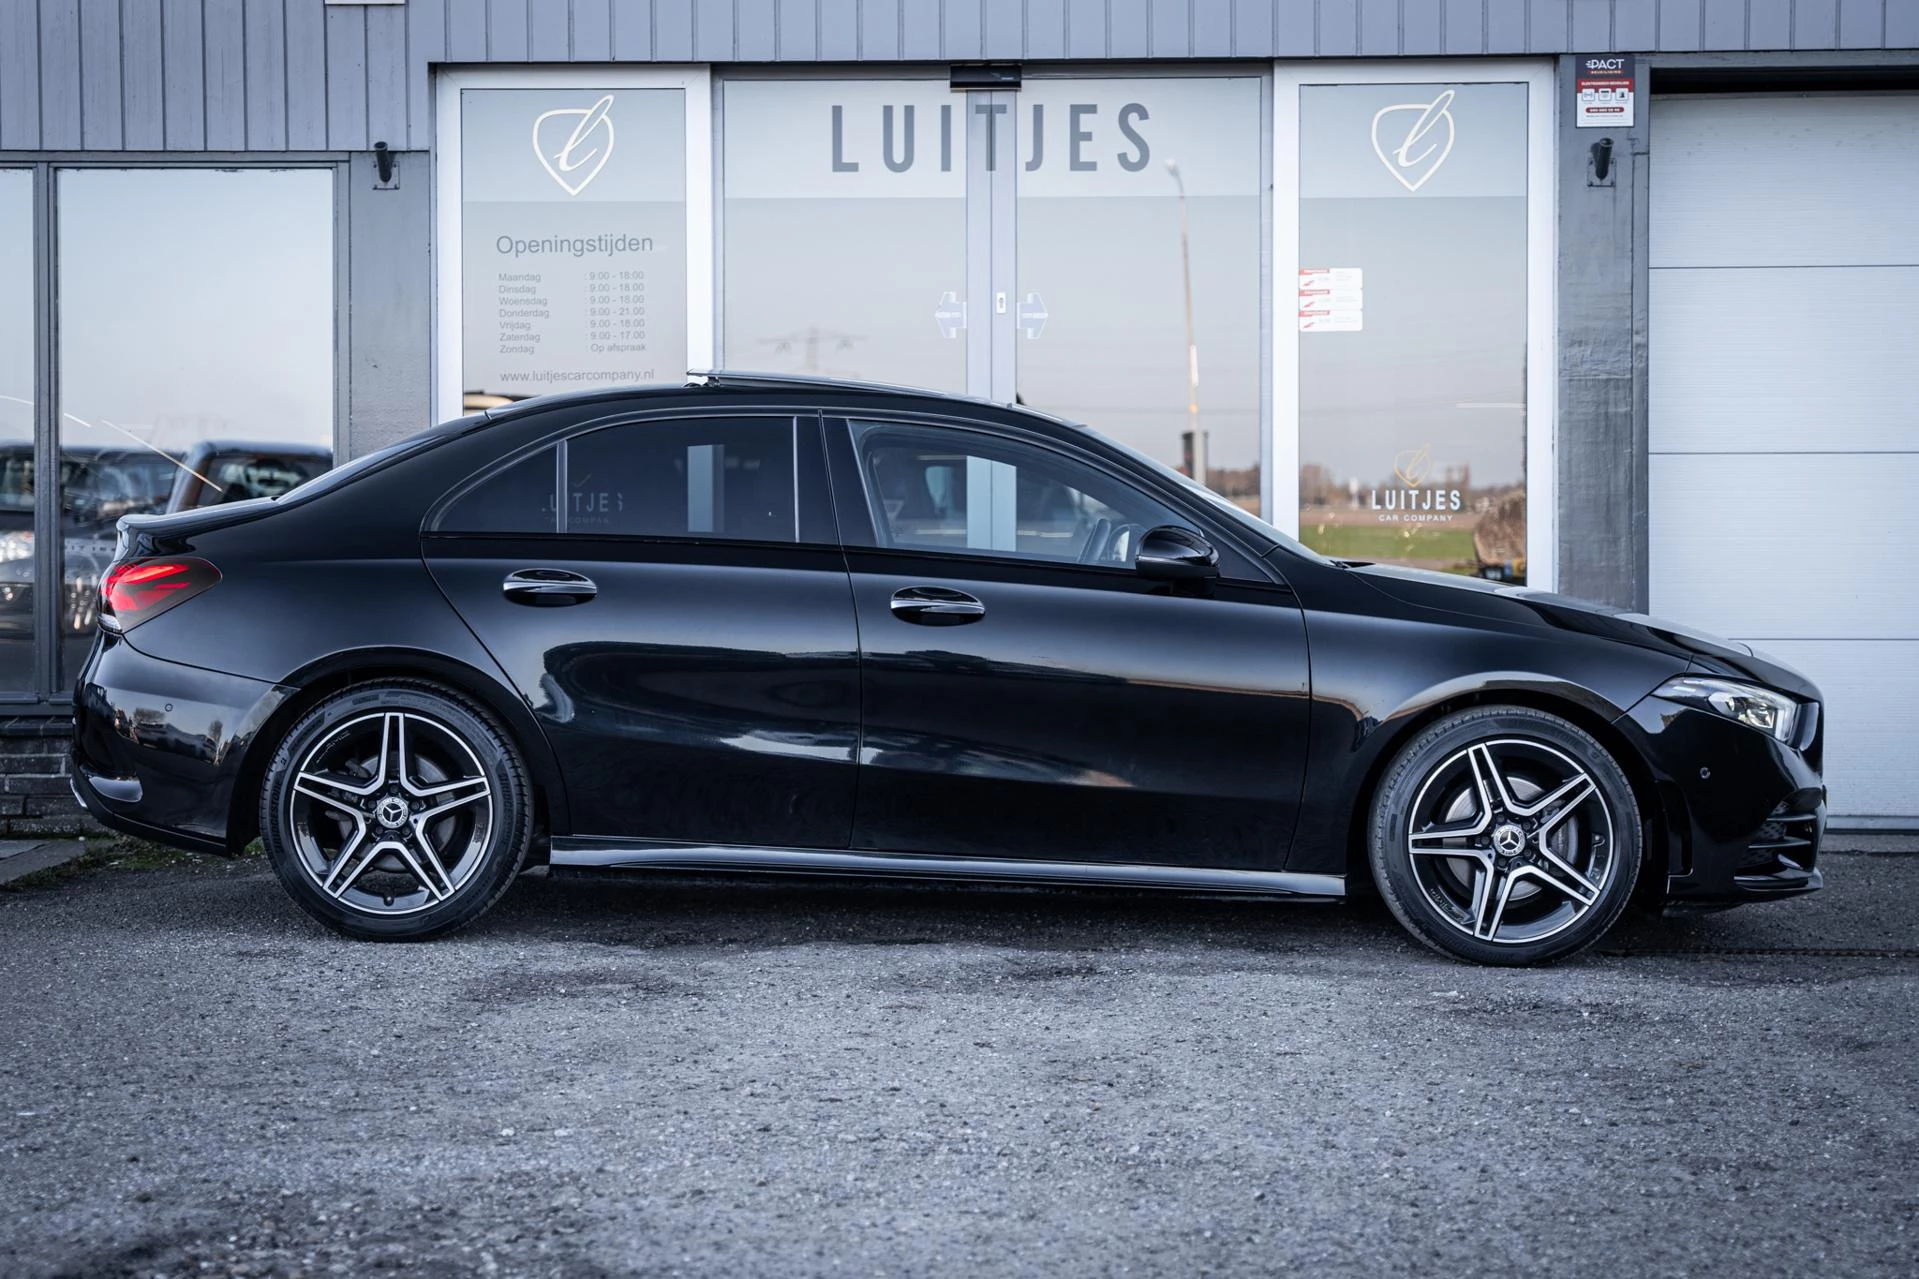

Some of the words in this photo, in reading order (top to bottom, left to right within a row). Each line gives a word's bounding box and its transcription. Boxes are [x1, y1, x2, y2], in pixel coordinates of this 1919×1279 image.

[1588, 59, 1624, 69] PACT
[831, 102, 1151, 173] LUITJES
[496, 234, 653, 258] Openingstijden
[499, 272, 541, 283] Maandag
[499, 284, 536, 295] Dinsdag
[499, 296, 548, 306] Woensdag
[499, 308, 550, 319] Donderdag
[499, 320, 531, 331] Vrijdag
[500, 332, 541, 343] Zaterdag
[500, 344, 535, 355] Zondag
[499, 368, 655, 384] www.luitjescarcompany.nl
[1371, 489, 1461, 511] LUITJES
[1379, 514, 1399, 522] CAR
[1404, 514, 1454, 522] COMPANY
